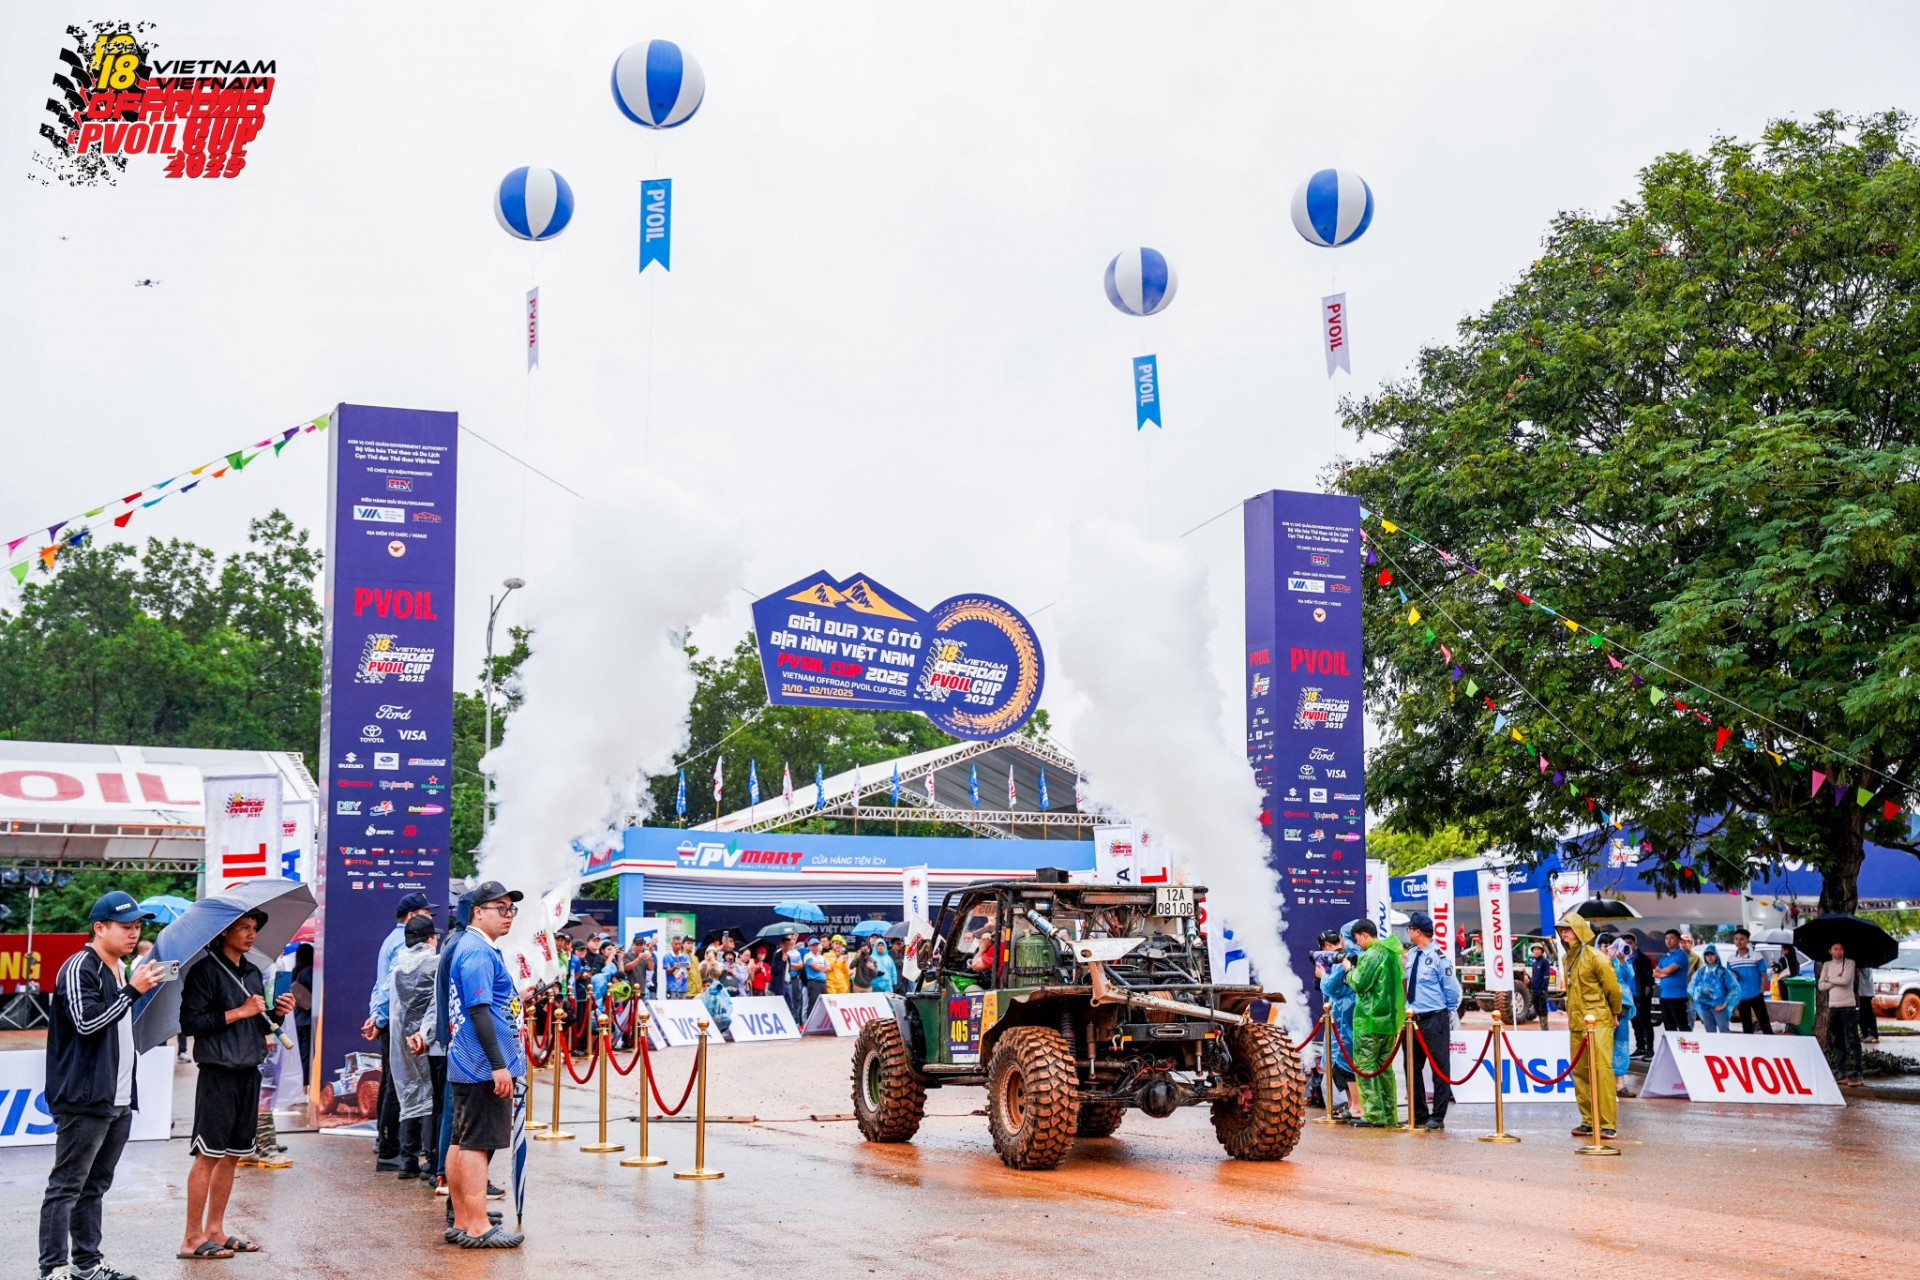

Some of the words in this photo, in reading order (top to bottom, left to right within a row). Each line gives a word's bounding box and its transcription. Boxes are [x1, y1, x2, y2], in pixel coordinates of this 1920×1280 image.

[646, 188, 666, 242] PVOIL
[1327, 303, 1343, 352] PVOIL
[1139, 364, 1154, 406] PVOIL
[354, 587, 437, 620] PVOIL
[788, 611, 820, 633] GIẢI
[824, 620, 858, 639] ĐUA
[862, 626, 885, 643] XE
[888, 628, 922, 649] ÔTÔ
[374, 639, 391, 652] 18
[770, 630, 798, 650] ĐỊA
[801, 634, 838, 655] HÌNH
[841, 642, 877, 663] VIỆT
[880, 649, 915, 668] NAM
[940, 645, 958, 661] 18
[370, 650, 433, 662] OFFROAD
[963, 658, 1008, 670] VIETNAM
[1250, 649, 1270, 667] PVOIL
[1291, 648, 1350, 676] PVOIL
[368, 661, 404, 674] PVOIL
[404, 663, 431, 674] CUP
[777, 652, 825, 673] PVOIL
[829, 661, 862, 678] CUP
[865, 666, 910, 686] 2025
[935, 660, 1007, 682] OFFROAD
[782, 671, 815, 682] VIETNAM
[816, 676, 850, 688] OFFROAD
[851, 682, 871, 692] PVOIL
[873, 685, 887, 693] CUP
[889, 687, 907, 697] 2025
[782, 683, 802, 693] 31/10
[809, 686, 854, 697] 02/11/2025
[929, 672, 972, 692] PVOIL
[972, 680, 1002, 696] CUP
[964, 694, 994, 706] 2025
[1307, 691, 1317, 701] 18
[376, 704, 412, 720] Ford
[1304, 702, 1349, 712] OFFROAD
[1302, 710, 1328, 721] PVOIL
[1328, 712, 1347, 722] CUP
[397, 729, 427, 740] VISA
[1309, 747, 1335, 761] Ford
[1325, 769, 1346, 778] VISA
[811, 854, 828, 865] CỬA
[830, 855, 852, 865] HÀNG
[854, 856, 870, 866] TIỆN
[872, 856, 886, 865] ÍCH
[1508, 871, 1528, 884] Ford
[1166, 889, 1185, 901] 12A
[1158, 902, 1193, 915] 081.06
[844, 914, 861, 923] ÔTÔ
[1490, 899, 1503, 950] GWM
[820, 924, 837, 934] VIỆT
[949, 1000, 970, 1018] PVOIL
[738, 1013, 787, 1035] VISA
[951, 1020, 968, 1042] 405
[1704, 1055, 1813, 1095] PVOIL
